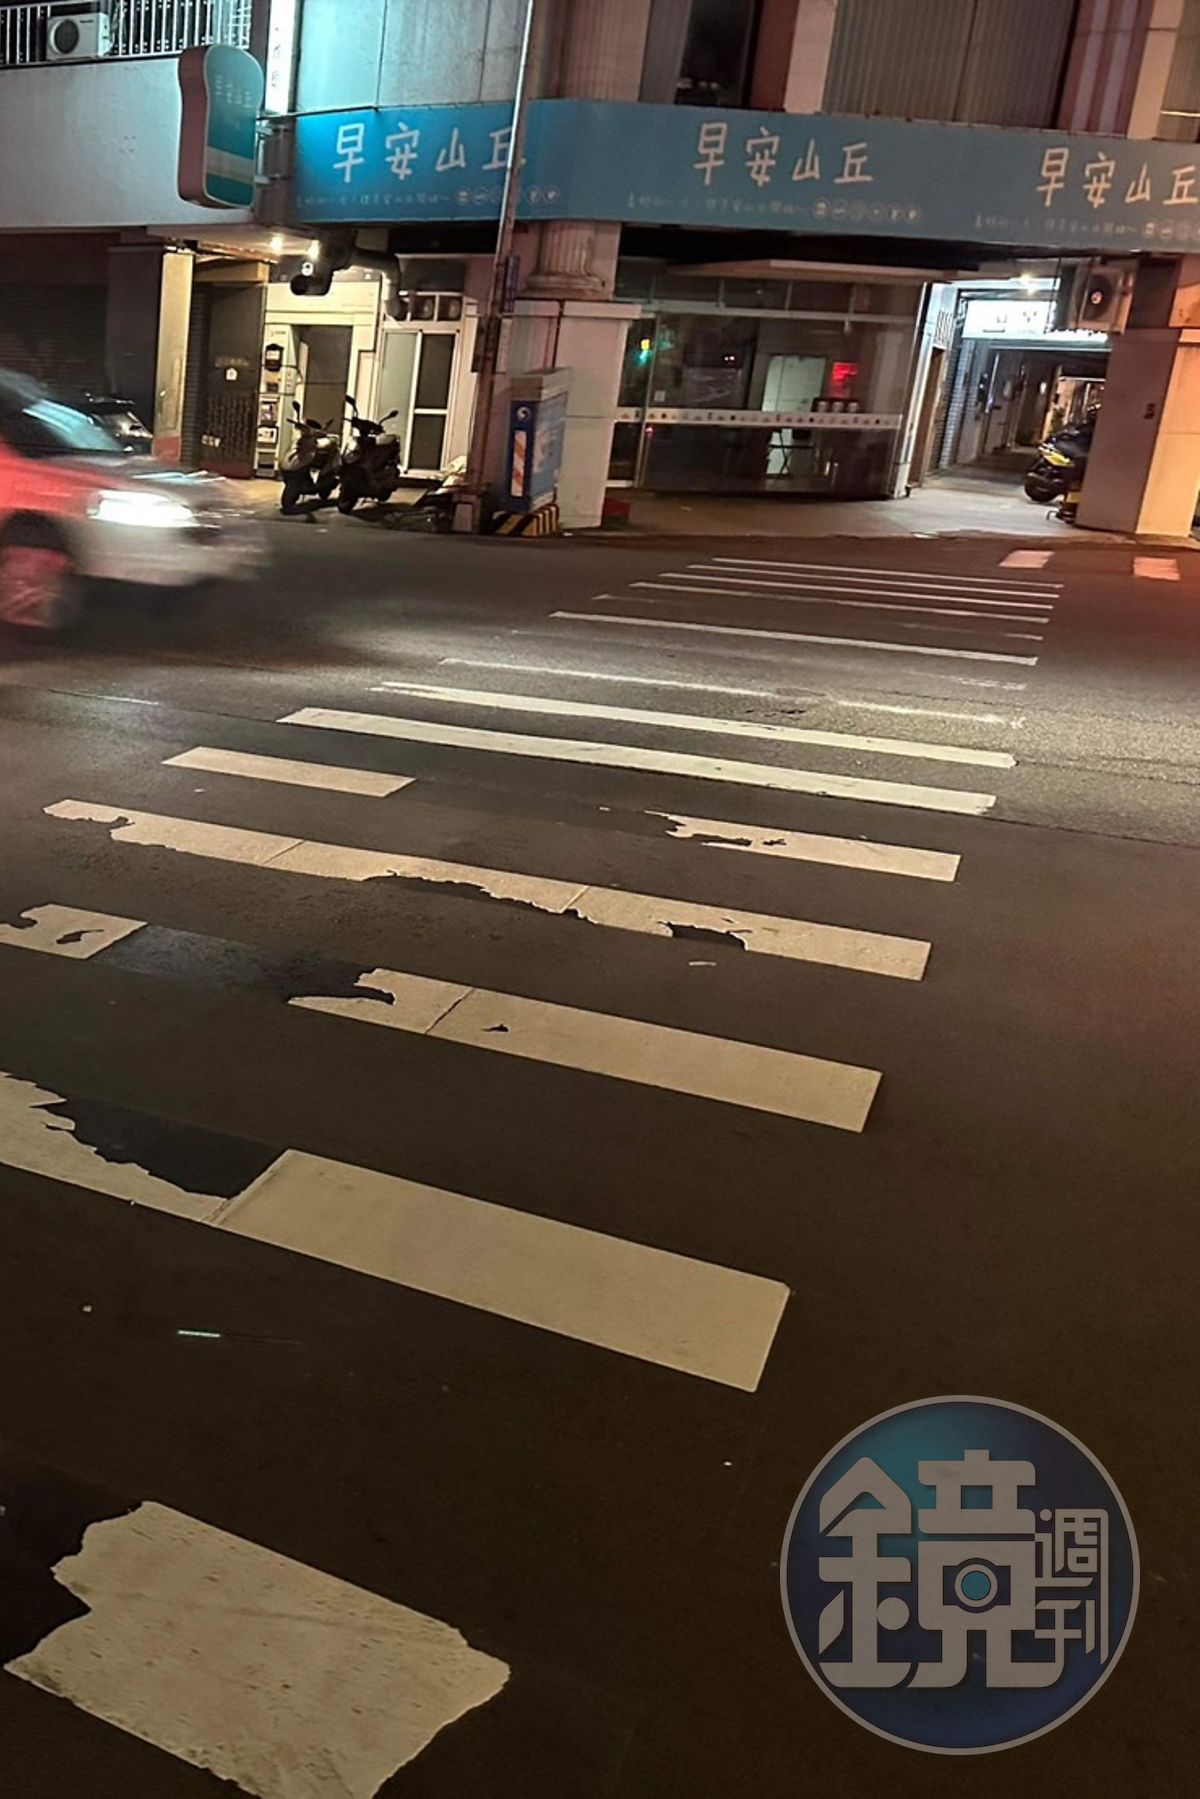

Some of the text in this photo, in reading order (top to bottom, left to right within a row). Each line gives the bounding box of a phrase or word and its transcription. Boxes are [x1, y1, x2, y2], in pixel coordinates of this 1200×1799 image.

[333, 121, 527, 184] 早安山丘
[693, 121, 874, 188] 早安山丘
[1036, 147, 1199, 209] 早安山丘
